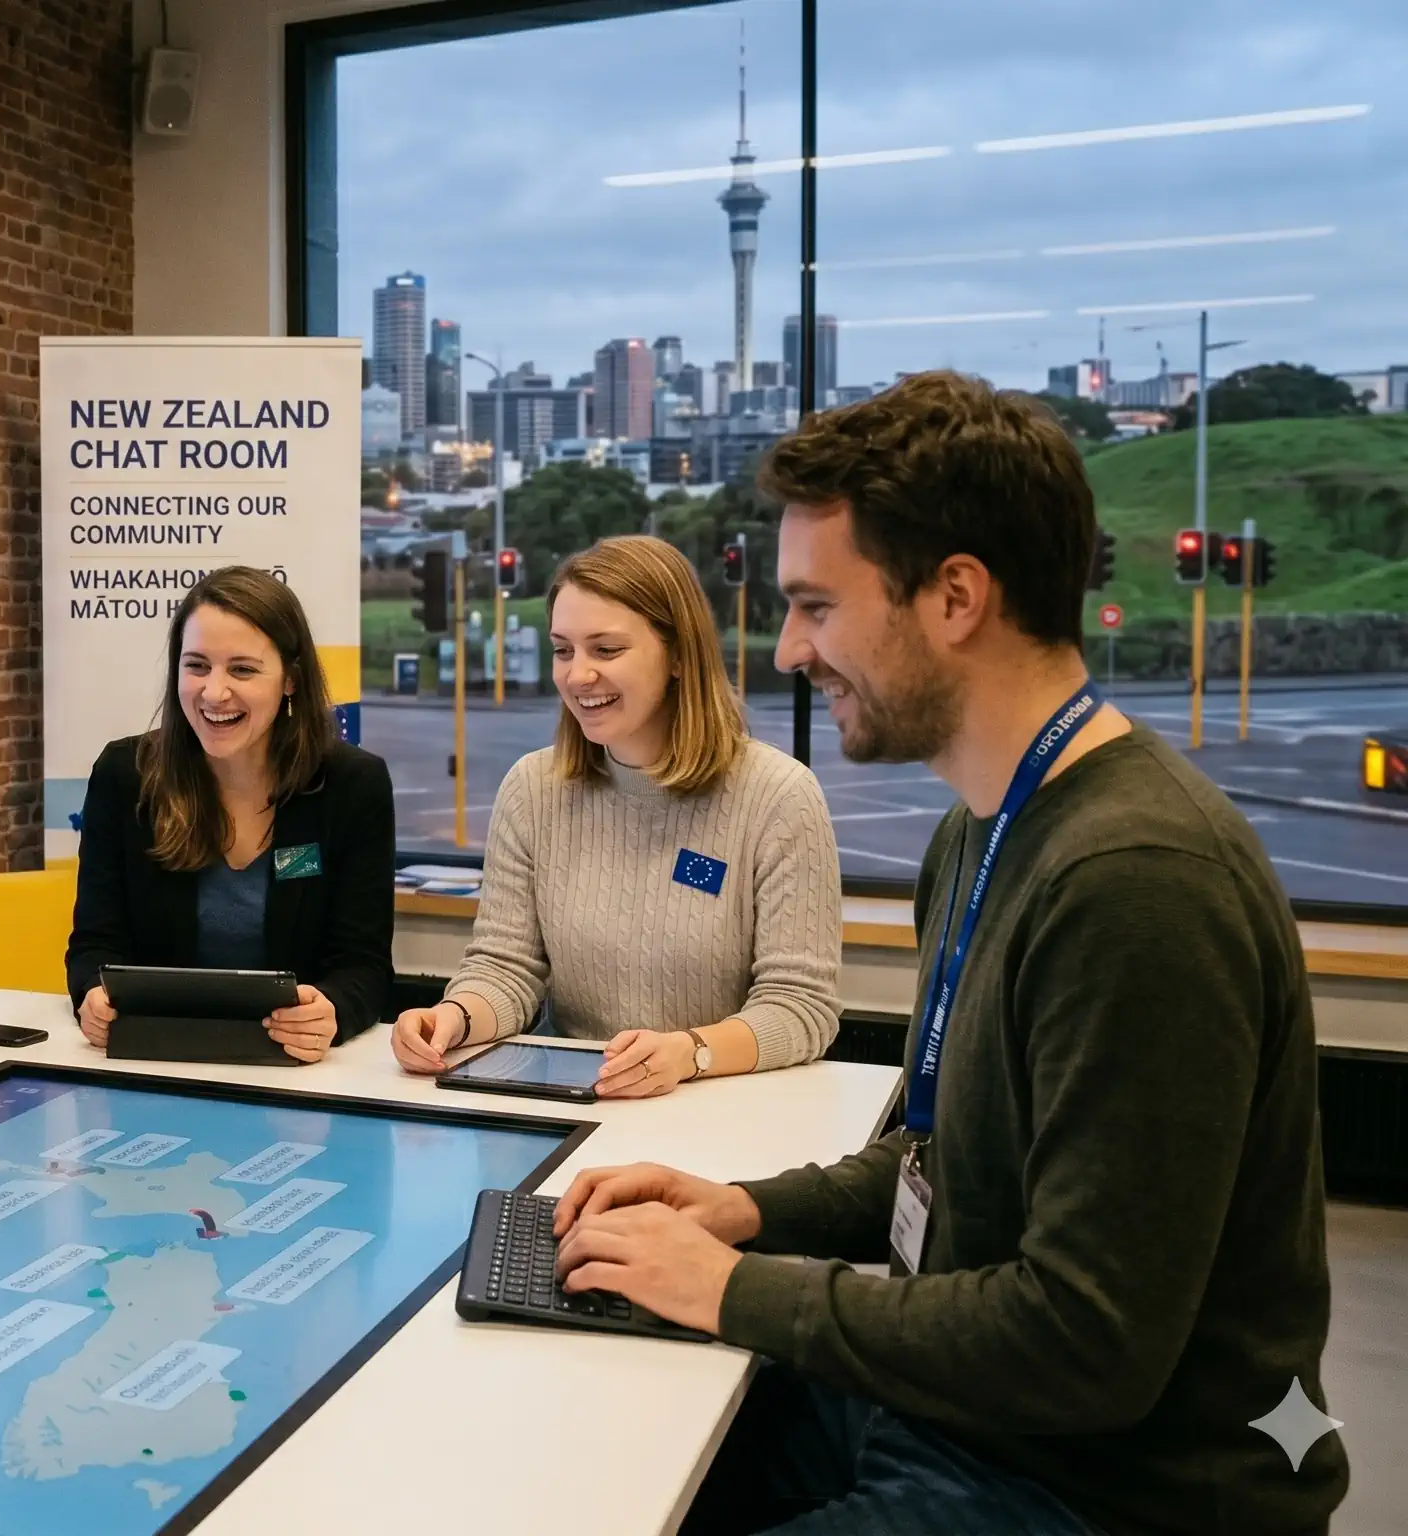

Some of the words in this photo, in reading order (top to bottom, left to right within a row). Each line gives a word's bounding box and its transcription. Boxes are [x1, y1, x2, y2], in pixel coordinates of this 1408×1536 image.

[70, 400, 151, 429] NEW
[162, 400, 330, 429] ZEALAND
[70, 439, 168, 469] CHAT
[180, 439, 288, 469] ROOM
[70, 496, 230, 516] CONNECTING
[237, 496, 287, 516] OUR
[70, 524, 224, 545] COMMUNITY
[70, 595, 158, 619] MĀTOU
